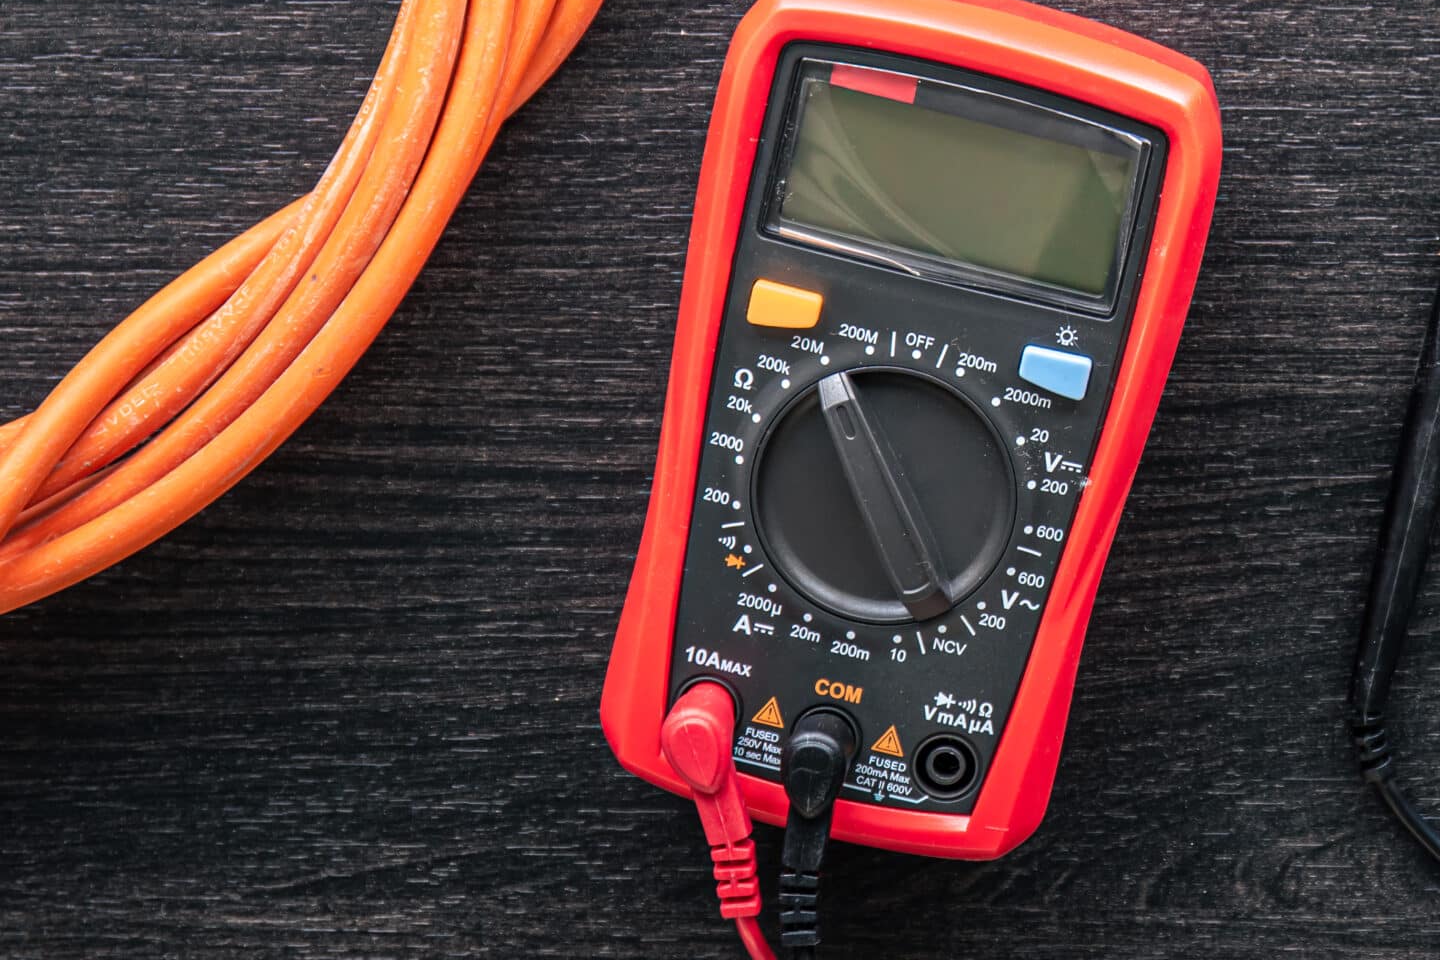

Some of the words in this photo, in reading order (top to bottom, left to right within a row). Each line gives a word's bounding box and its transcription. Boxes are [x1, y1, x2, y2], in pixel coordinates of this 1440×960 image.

[838, 323, 879, 345] 200M
[905, 332, 936, 351] OFF
[790, 335, 825, 355] 20M
[756, 354, 791, 376] 200k
[957, 352, 998, 373] 200m
[726, 395, 753, 415] 20k
[1003, 386, 1052, 409] 2000m
[709, 431, 744, 453] 2000
[1029, 427, 1050, 444] 20
[703, 487, 730, 505] 200
[1040, 478, 1069, 496] 200
[1036, 525, 1064, 542] 600
[1017, 571, 1045, 589] 600
[978, 612, 1006, 630] 200
[789, 624, 821, 643] 20m
[830, 640, 871, 661] 200m
[890, 647, 907, 663] 10
[932, 637, 968, 656] NCV
[814, 677, 864, 704] COM
[745, 727, 779, 743] FUSED
[733, 746, 744, 757] 10
[746, 751, 761, 761] sec
[763, 753, 781, 765] Max
[737, 736, 760, 749] 250V
[762, 741, 782, 756] Max
[868, 755, 907, 772] FUSED
[855, 763, 888, 779] 200mA
[889, 772, 911, 785] Max
[856, 775, 875, 789] CAT
[886, 782, 913, 796] 600V
